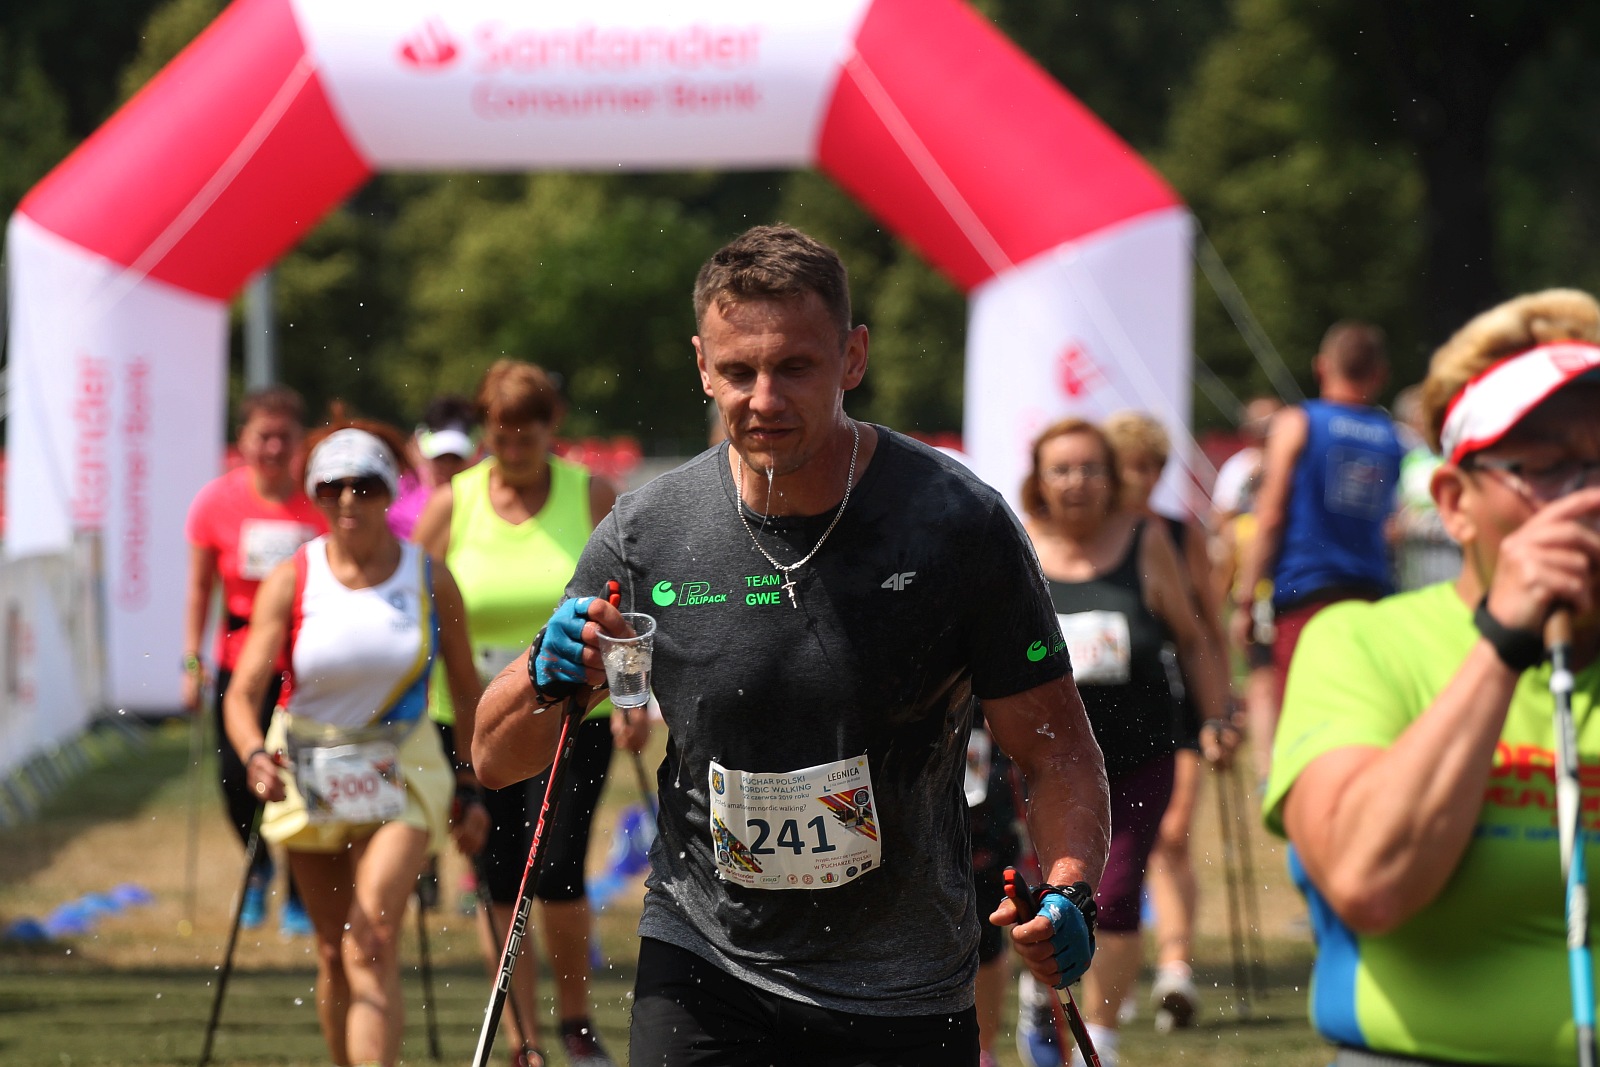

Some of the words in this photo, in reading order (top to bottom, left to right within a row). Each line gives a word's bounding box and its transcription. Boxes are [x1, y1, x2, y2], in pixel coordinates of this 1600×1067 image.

[471, 19, 762, 73] Santander
[745, 574, 780, 587] TEAM
[881, 571, 916, 591] 4F
[678, 581, 727, 606] POLIPACK
[745, 591, 780, 606] GWE
[742, 777, 775, 786] PUCHAR
[776, 775, 807, 786] POLSKI
[827, 766, 860, 782] LEGNICA
[326, 772, 380, 803] 200
[740, 784, 770, 794] NORDIC
[772, 783, 812, 794] WALKING
[795, 792, 810, 800] roku
[757, 803, 778, 812] nordic
[779, 803, 807, 813] walking?
[747, 815, 837, 855] 241
